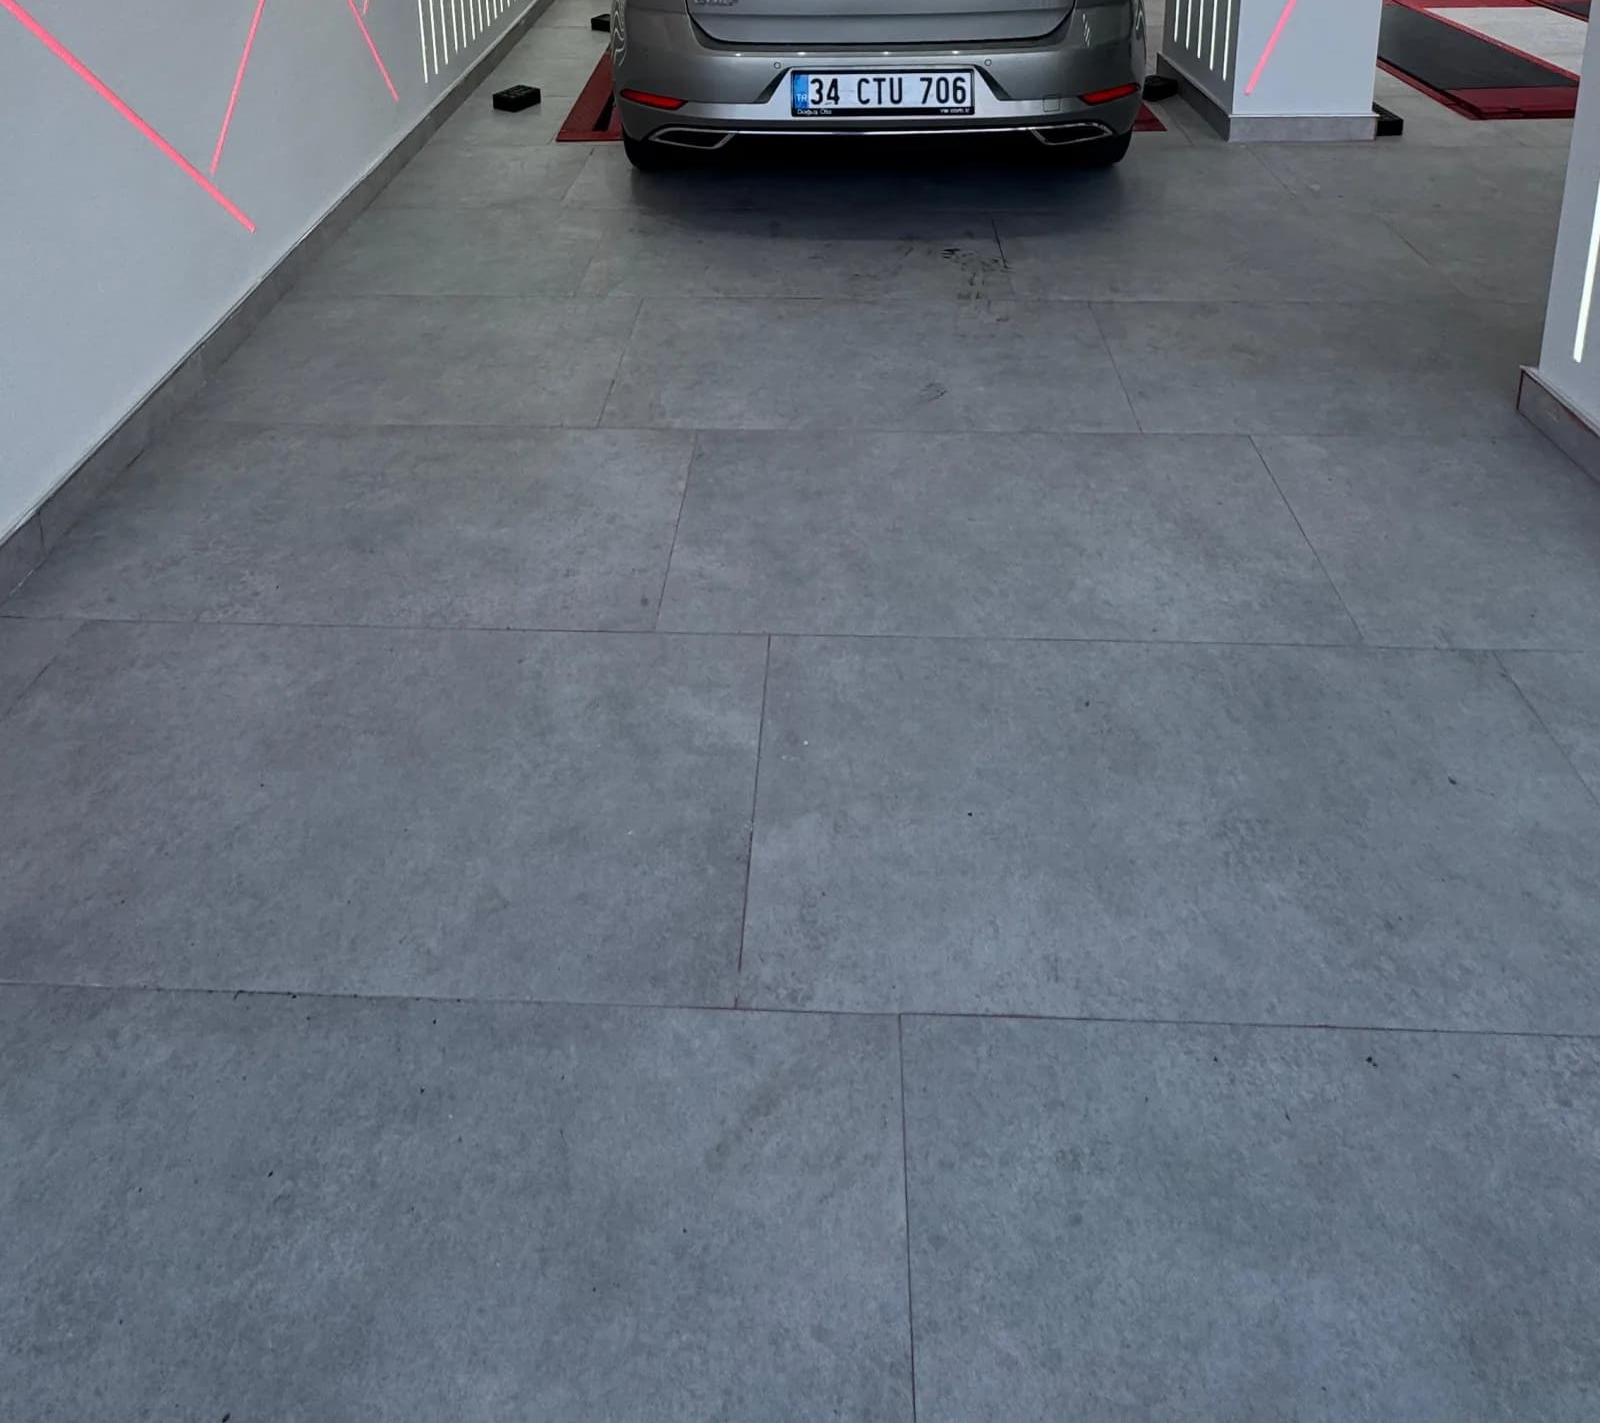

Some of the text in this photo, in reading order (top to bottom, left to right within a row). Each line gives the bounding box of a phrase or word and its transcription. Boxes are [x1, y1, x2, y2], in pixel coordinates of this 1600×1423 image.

[795, 77, 967, 105] TR 34 CTU 706
